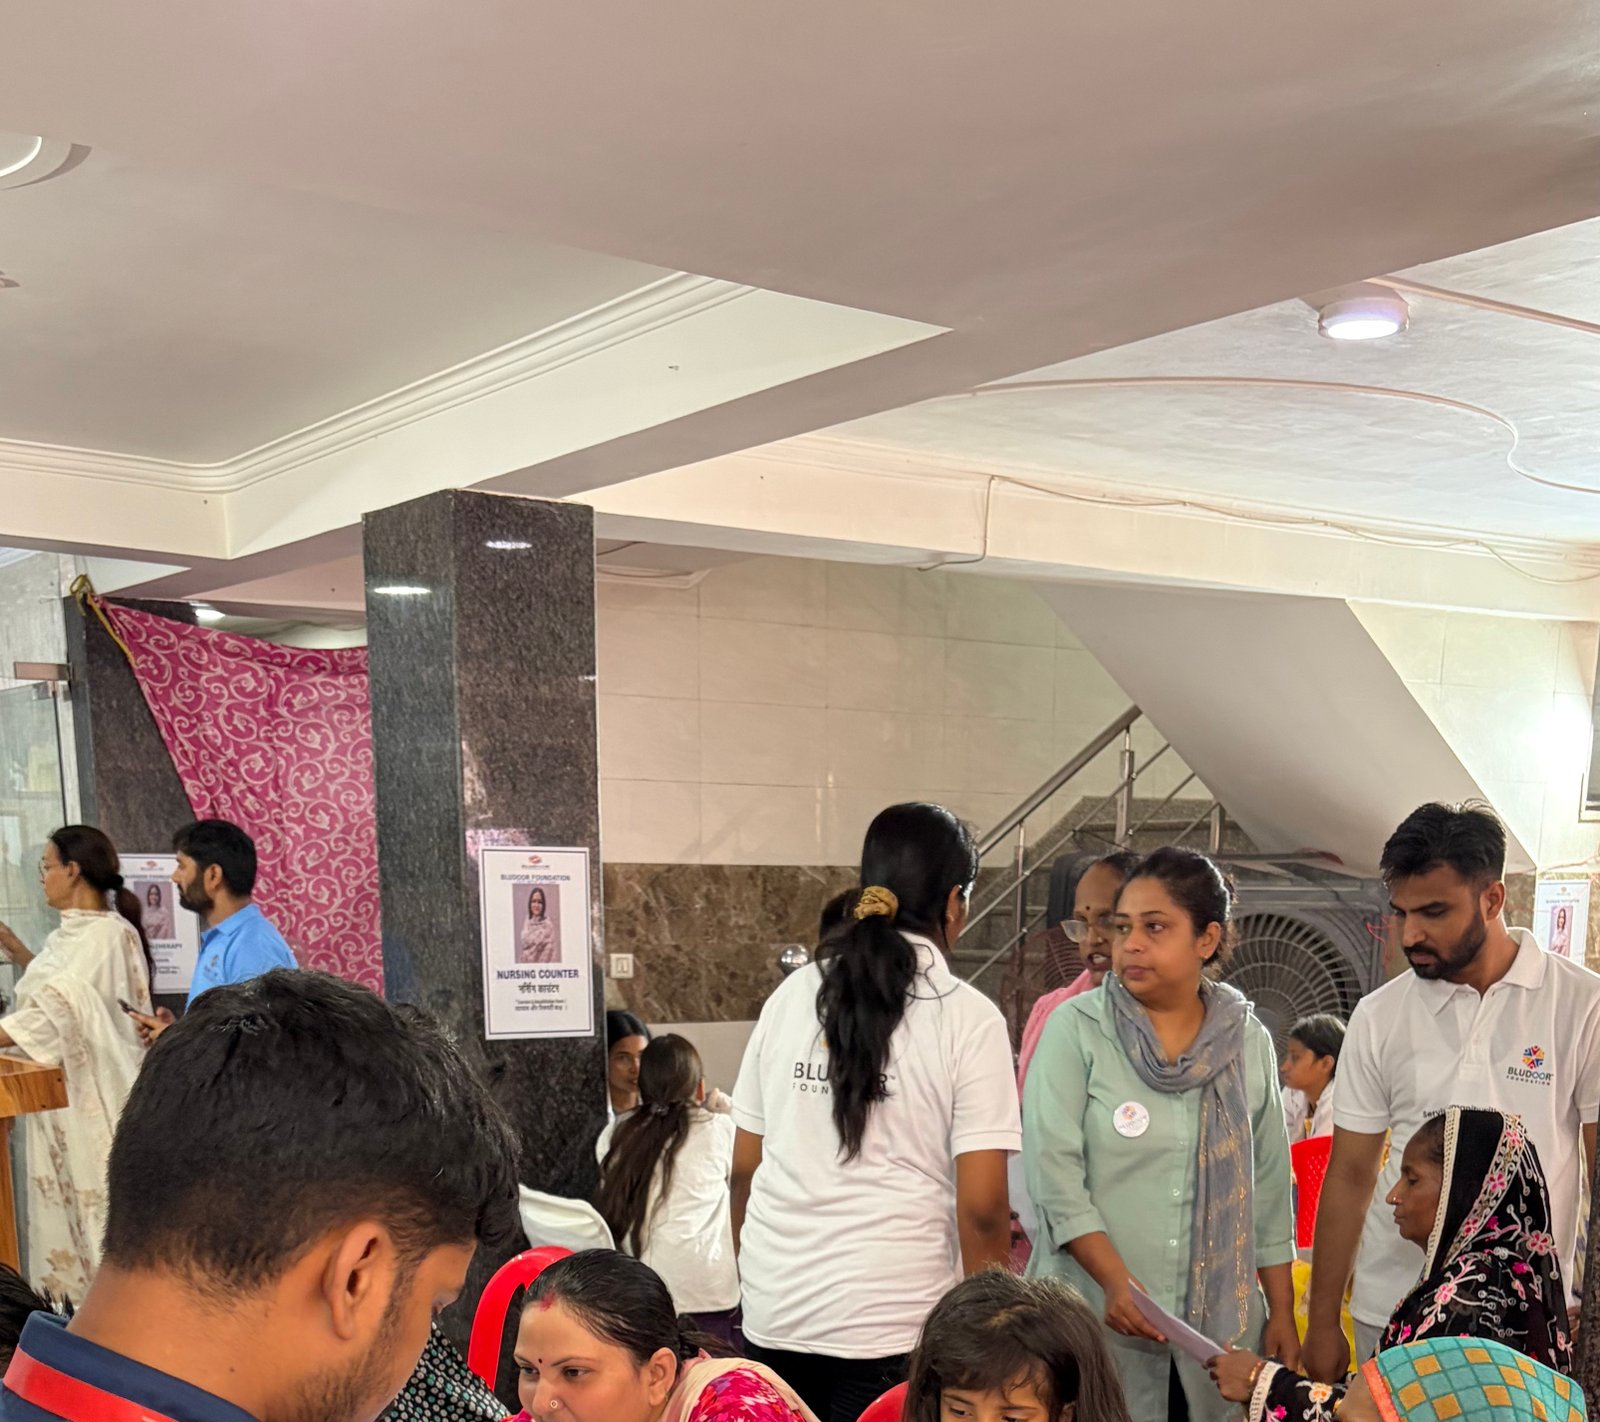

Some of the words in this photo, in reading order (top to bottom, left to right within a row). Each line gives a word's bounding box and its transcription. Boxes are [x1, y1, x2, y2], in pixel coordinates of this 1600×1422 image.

[497, 969, 536, 979] NURSING
[538, 969, 579, 979] COUNTER
[1507, 1066, 1552, 1081] BLUDOOR
